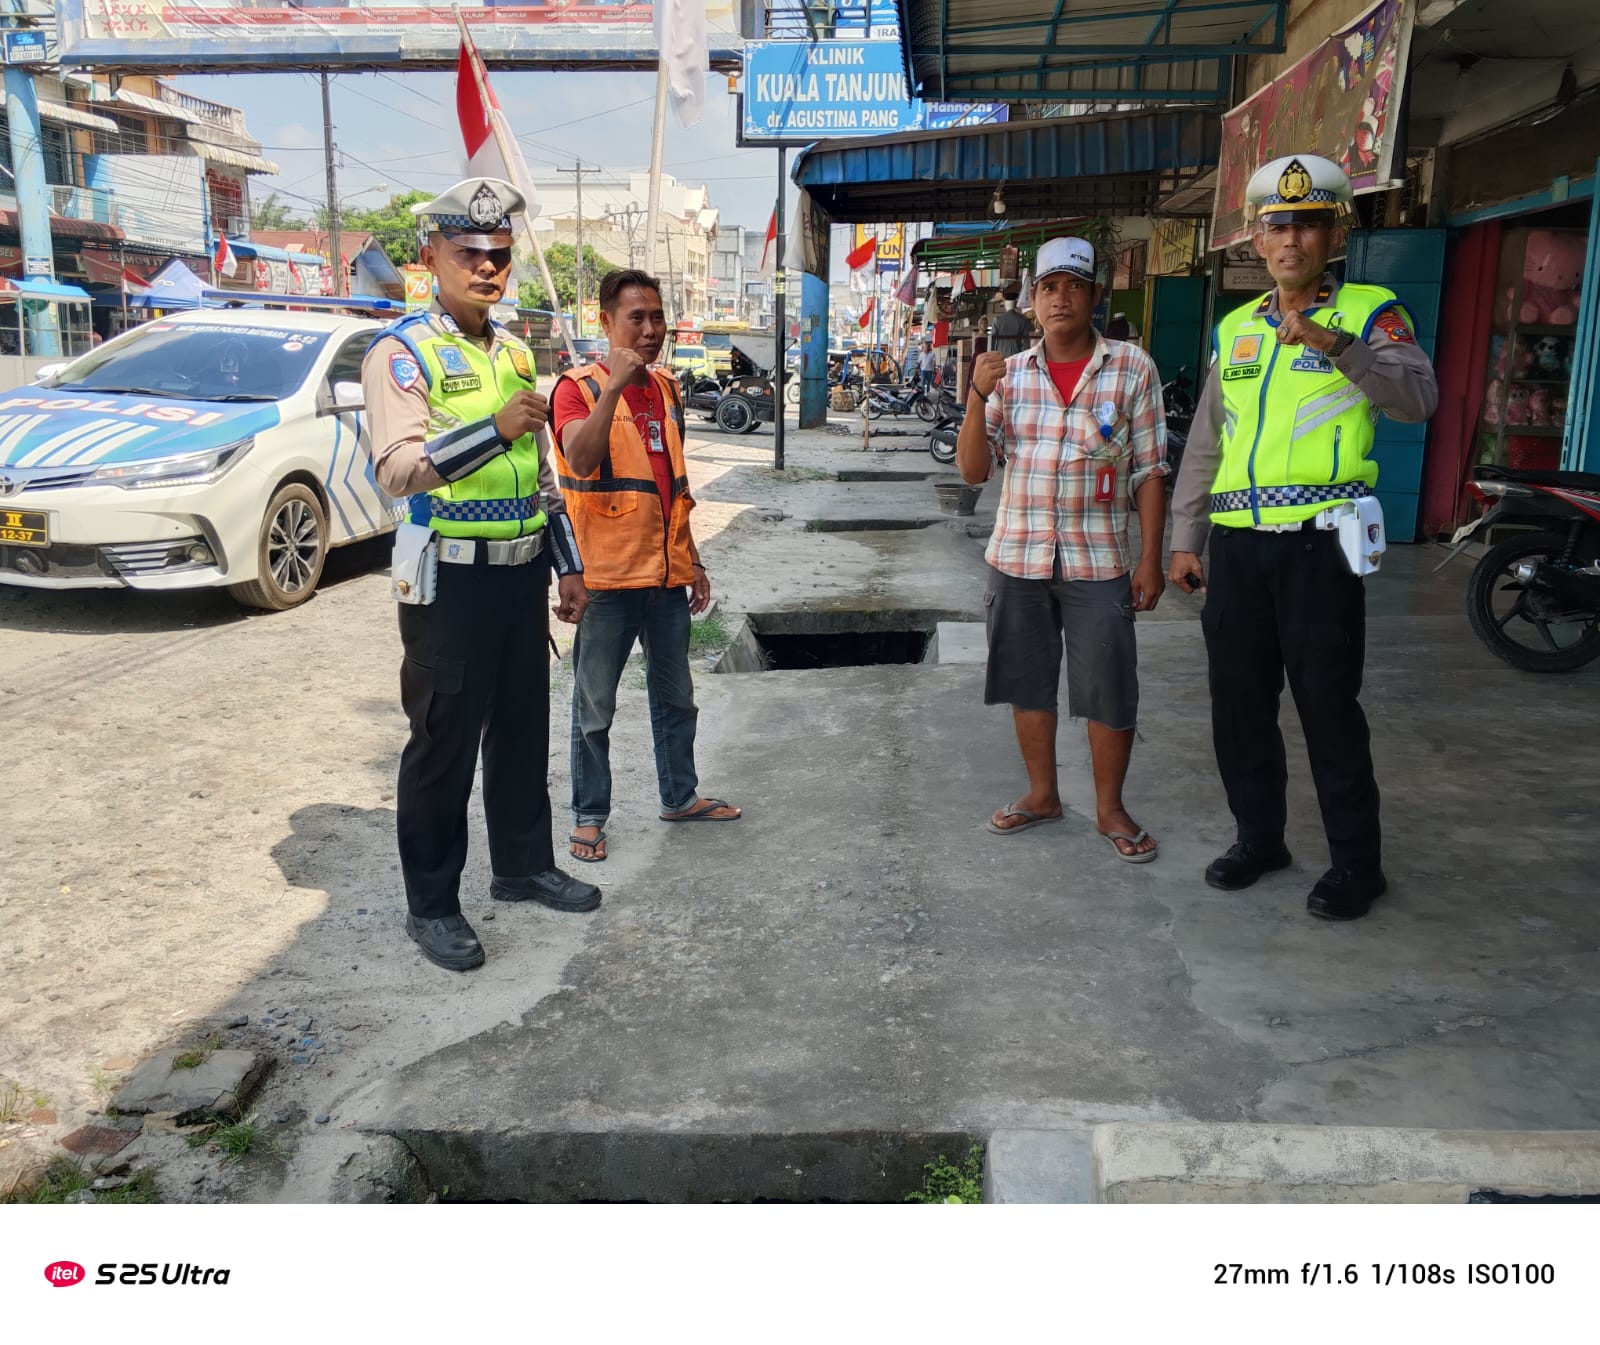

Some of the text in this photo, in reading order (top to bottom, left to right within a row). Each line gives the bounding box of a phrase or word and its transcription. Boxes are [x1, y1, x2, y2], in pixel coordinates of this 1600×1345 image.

[807, 47, 864, 65] KLINIK
[756, 73, 819, 103] KUALA
[767, 109, 898, 128] dr. AGUSTINA PANG
[0, 398, 225, 426] POLISI
